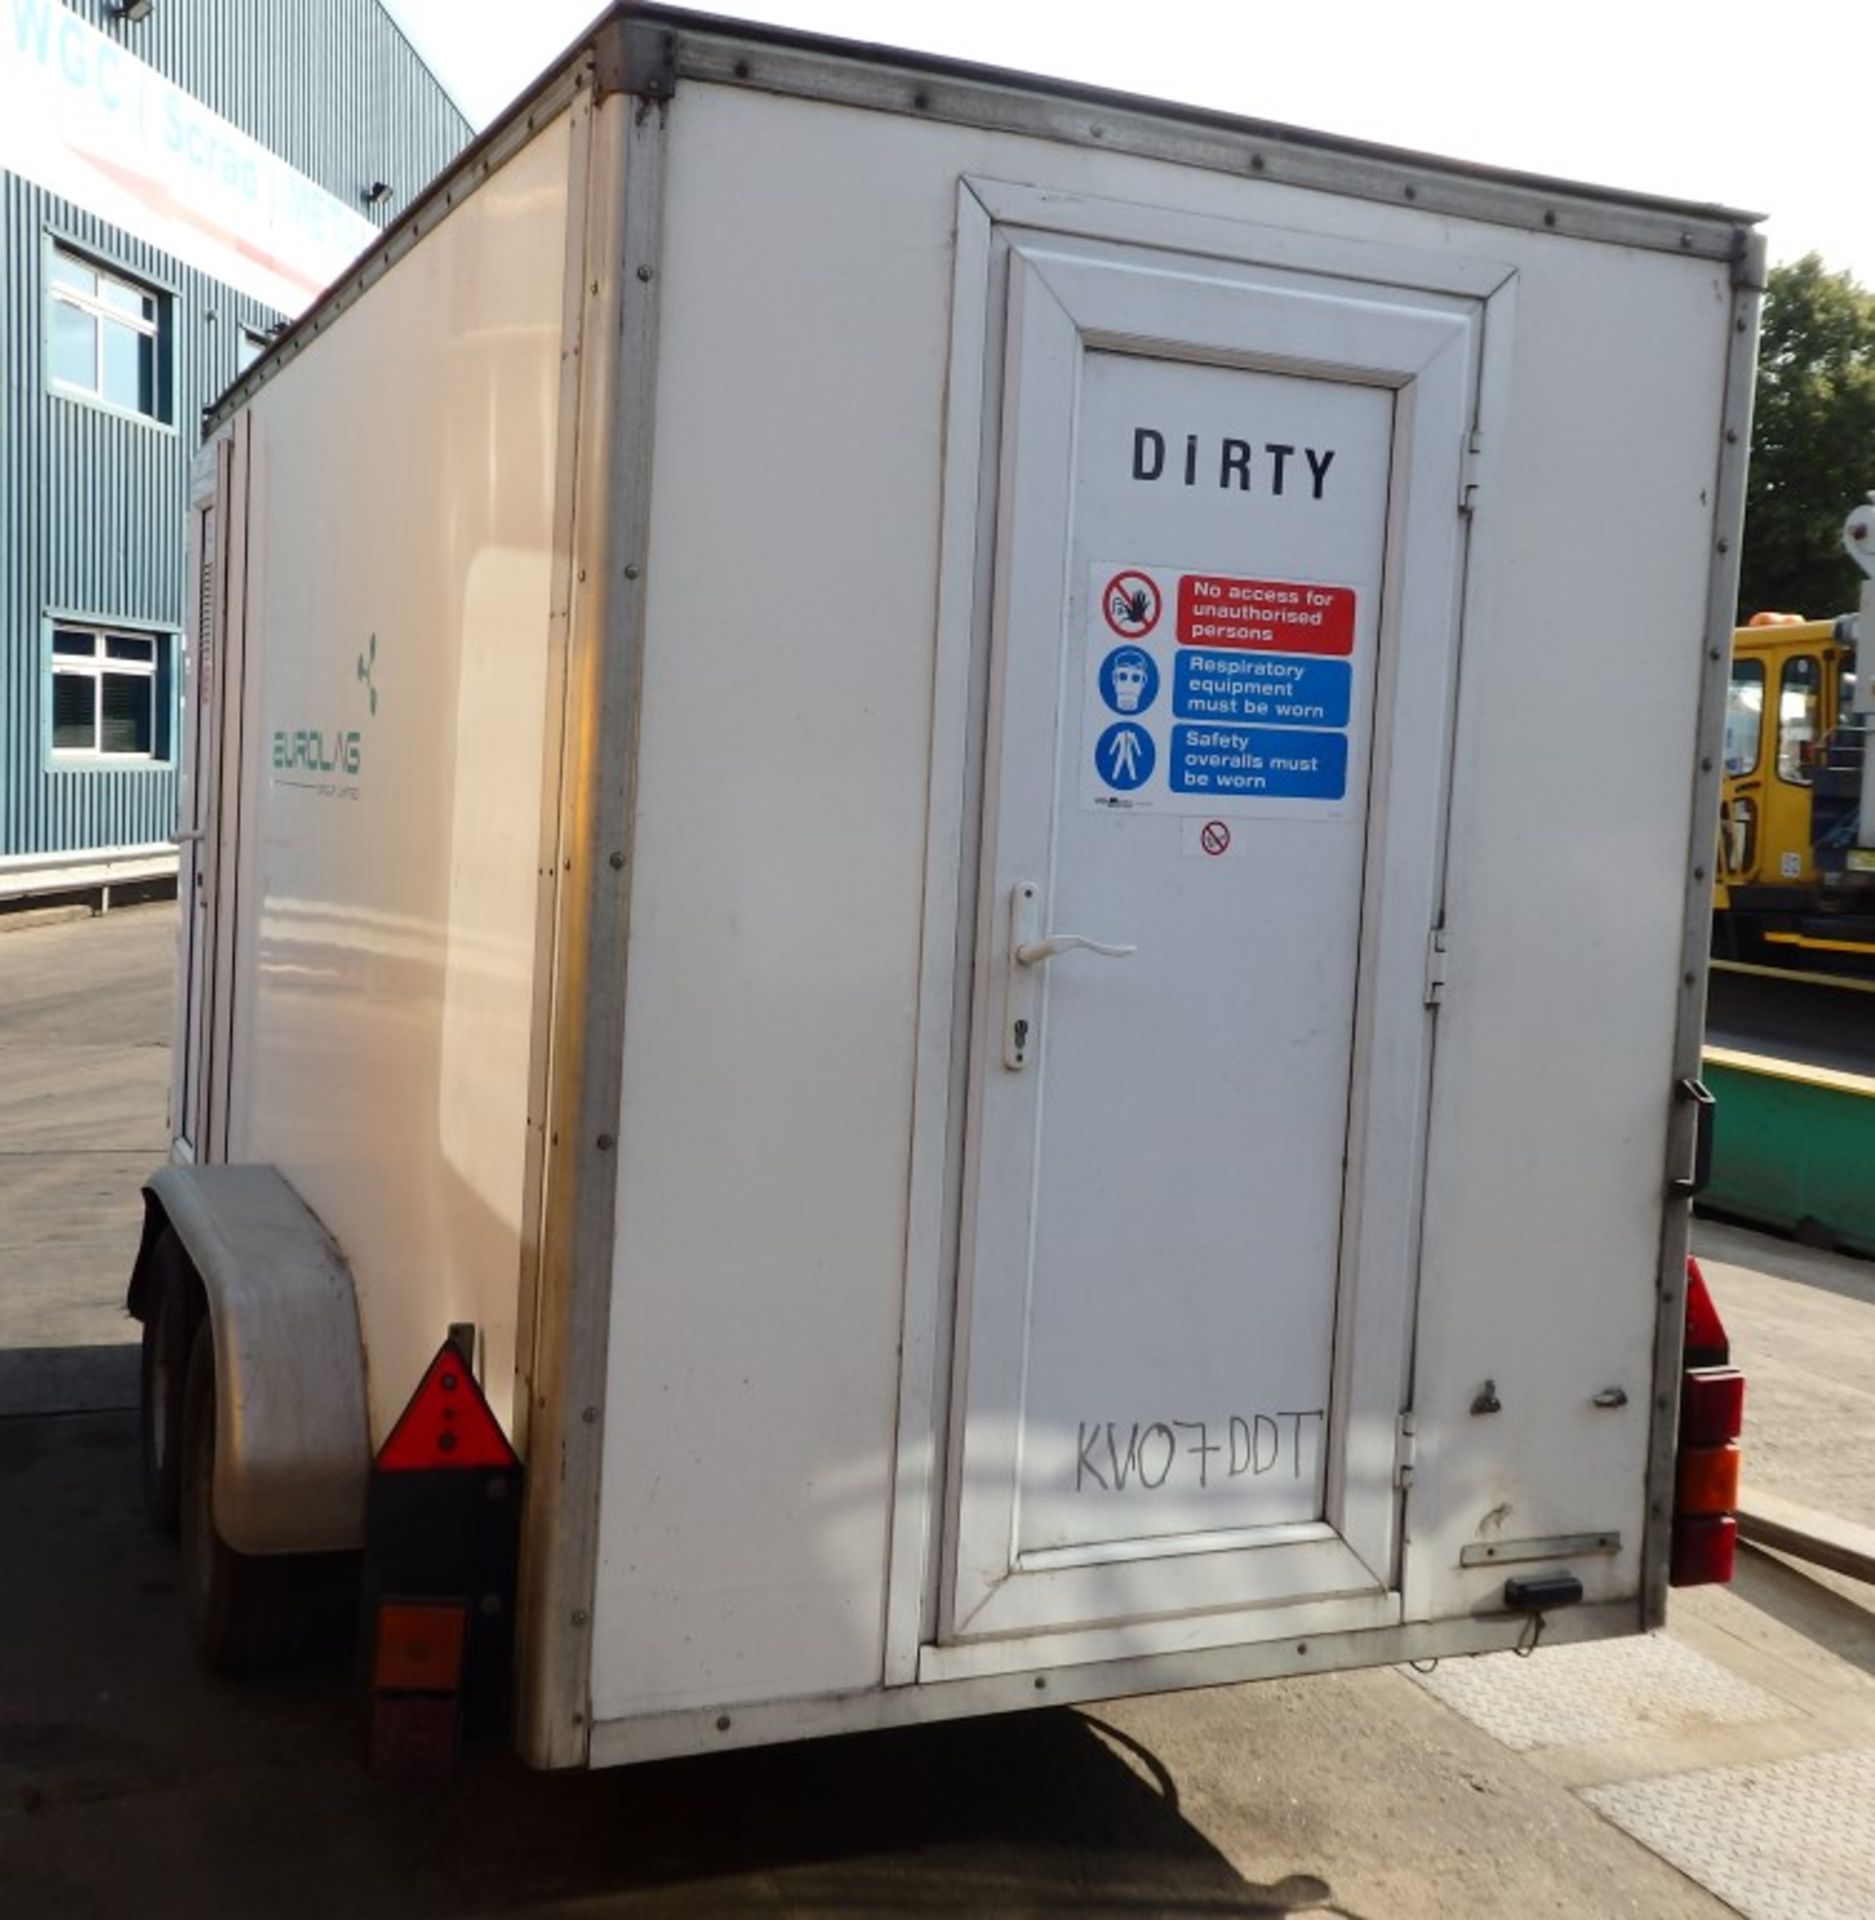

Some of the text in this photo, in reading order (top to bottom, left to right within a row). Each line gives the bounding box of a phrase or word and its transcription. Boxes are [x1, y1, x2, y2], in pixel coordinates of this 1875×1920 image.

[1194, 582, 1334, 606] No access for
[1193, 604, 1323, 626] unauthorised
[1192, 624, 1274, 641] persons
[1189, 656, 1305, 681] Respiratory
[1189, 678, 1294, 697] equipment
[1187, 698, 1324, 718] must be worn
[1186, 731, 1249, 751] Safety
[1184, 753, 1318, 771] overalls must
[1184, 771, 1266, 788] be worn
